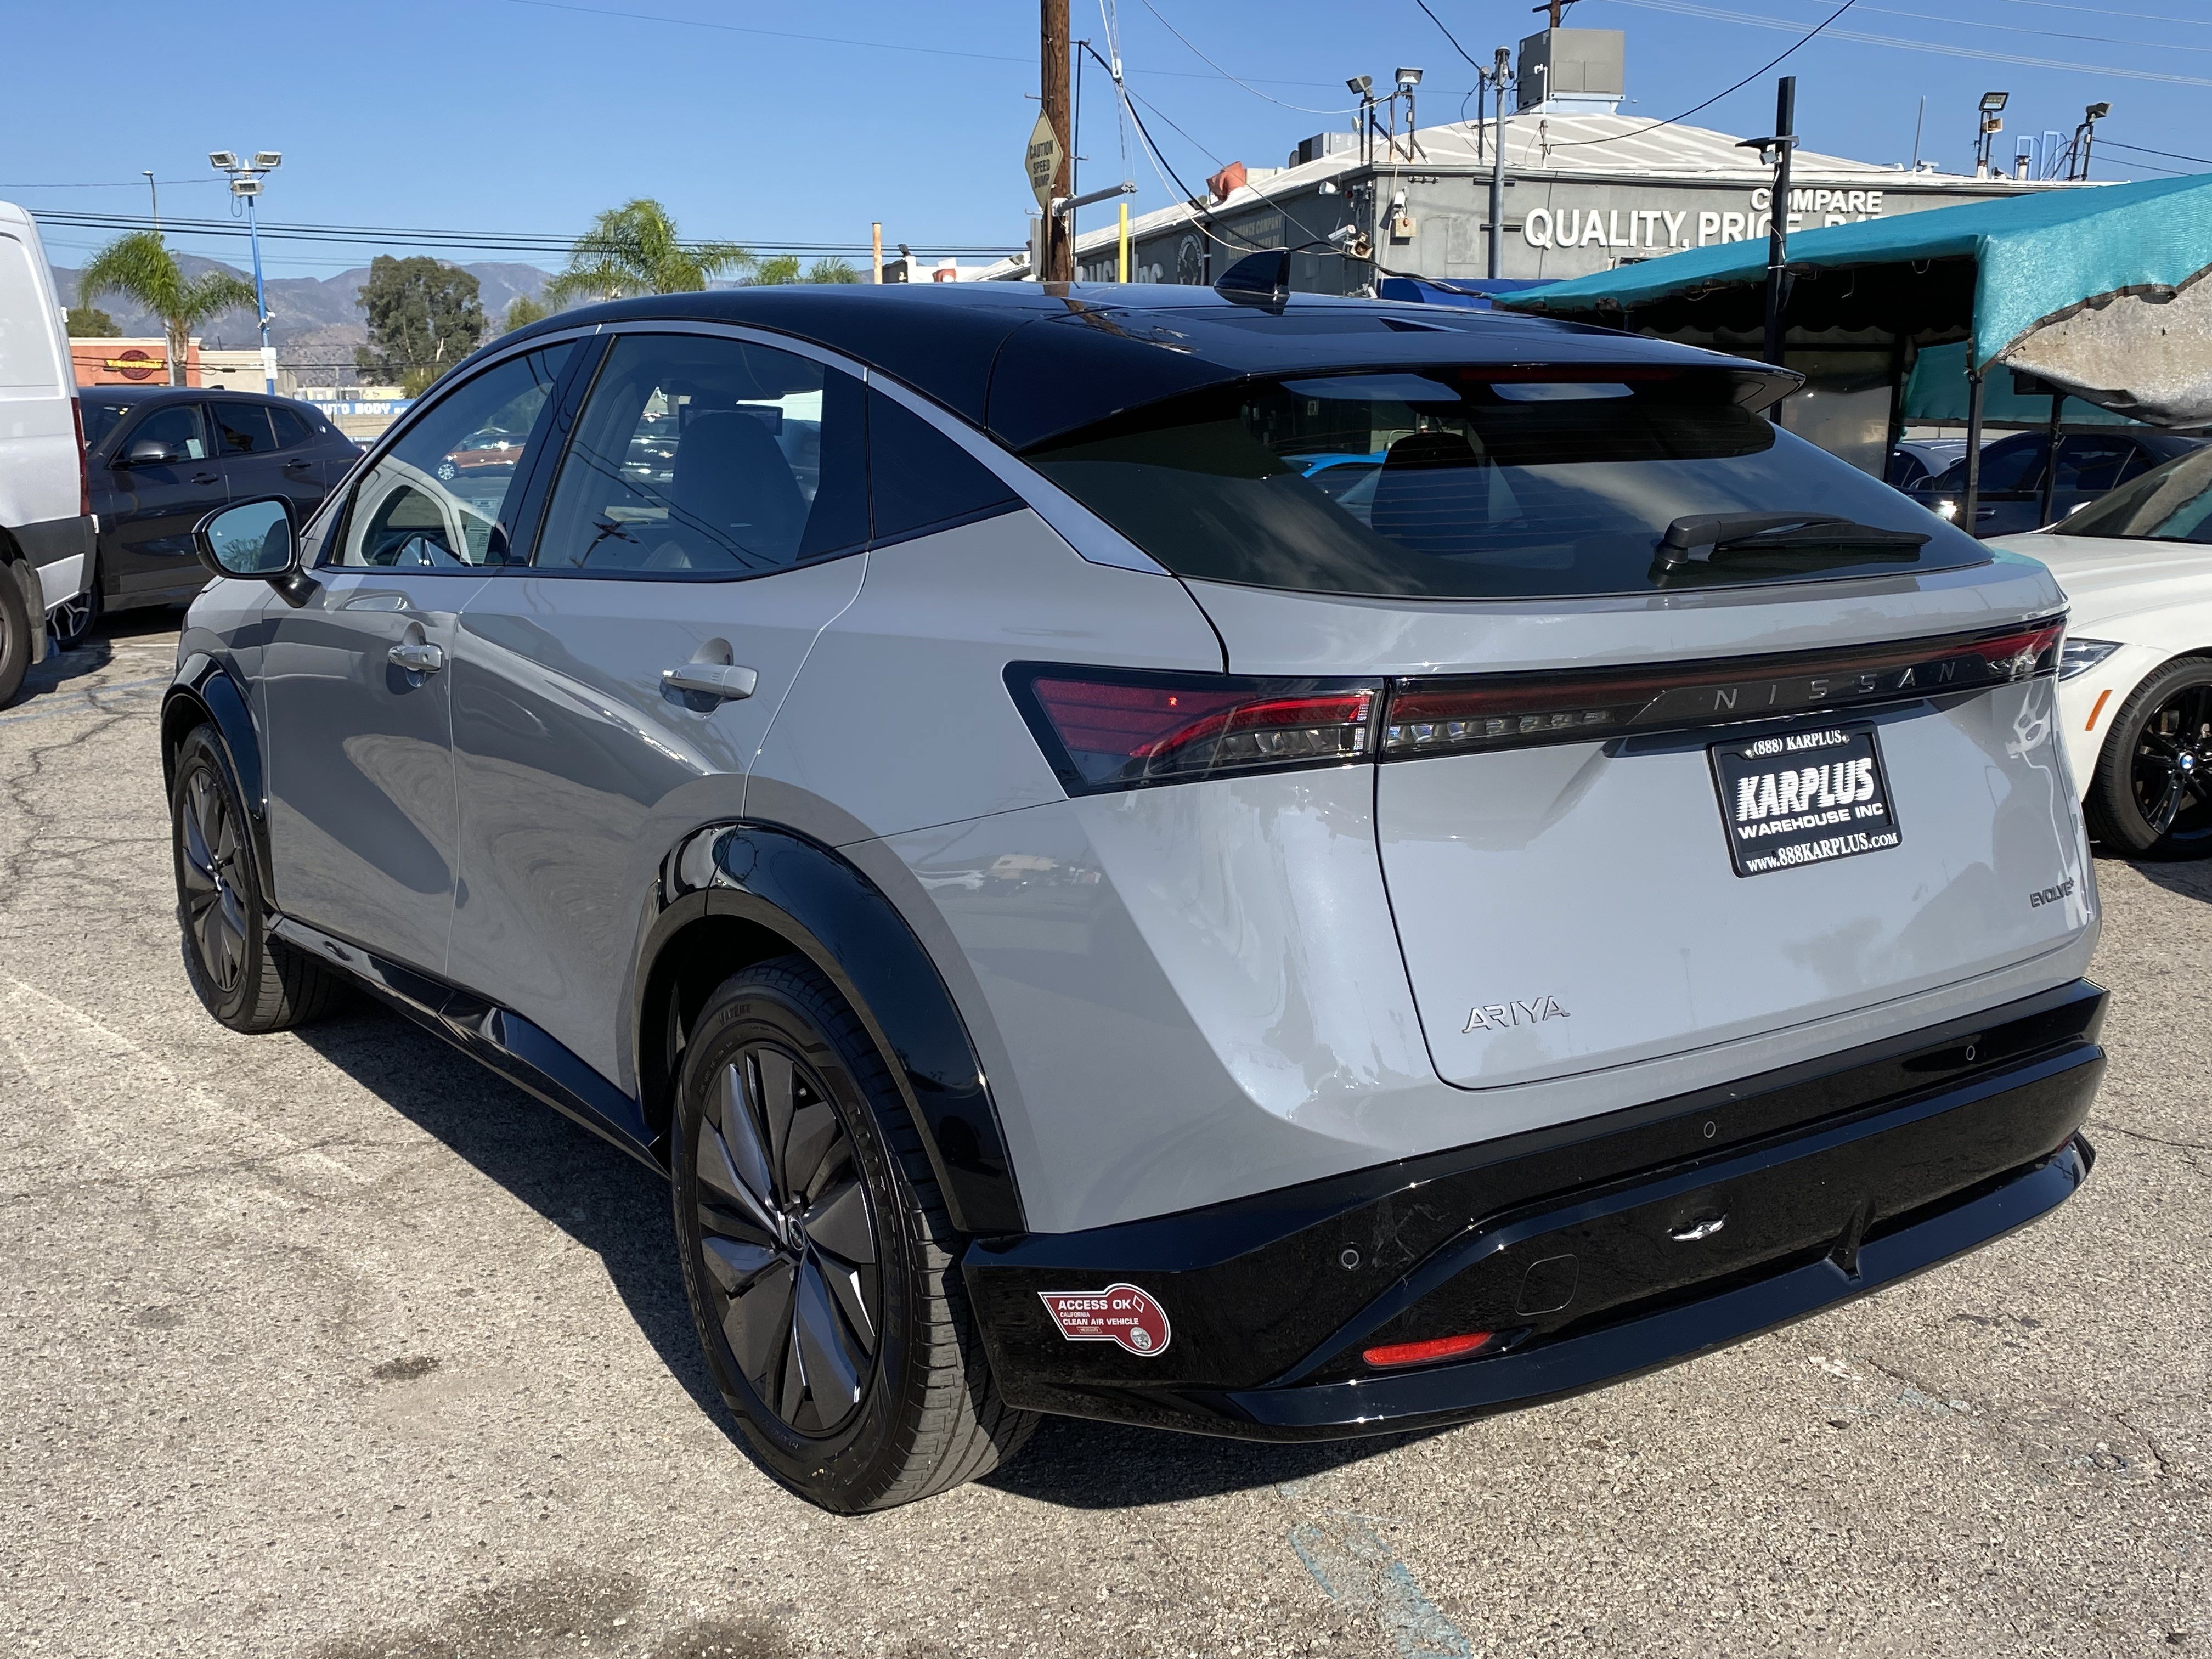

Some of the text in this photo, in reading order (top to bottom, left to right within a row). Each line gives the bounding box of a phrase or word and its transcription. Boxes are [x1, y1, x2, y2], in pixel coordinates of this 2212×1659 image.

[1030, 140, 1053, 160] CAUTION
[1033, 159, 1050, 174] SPEED
[1034, 173, 1049, 188] BUMP
[1751, 188, 1883, 213] CMPARE
[1525, 207, 1691, 250] QUALITY,
[355, 403, 391, 415] BODY
[1713, 662, 1956, 711] NISSAN
[1754, 730, 1842, 755] (888) KARPLUS
[1736, 757, 1874, 822] KARPLUS
[1737, 803, 1883, 839] WAREHOUSE INC
[1462, 995, 1571, 1034] ARIYA
[1058, 1299, 1131, 1311] ACCESS OK
